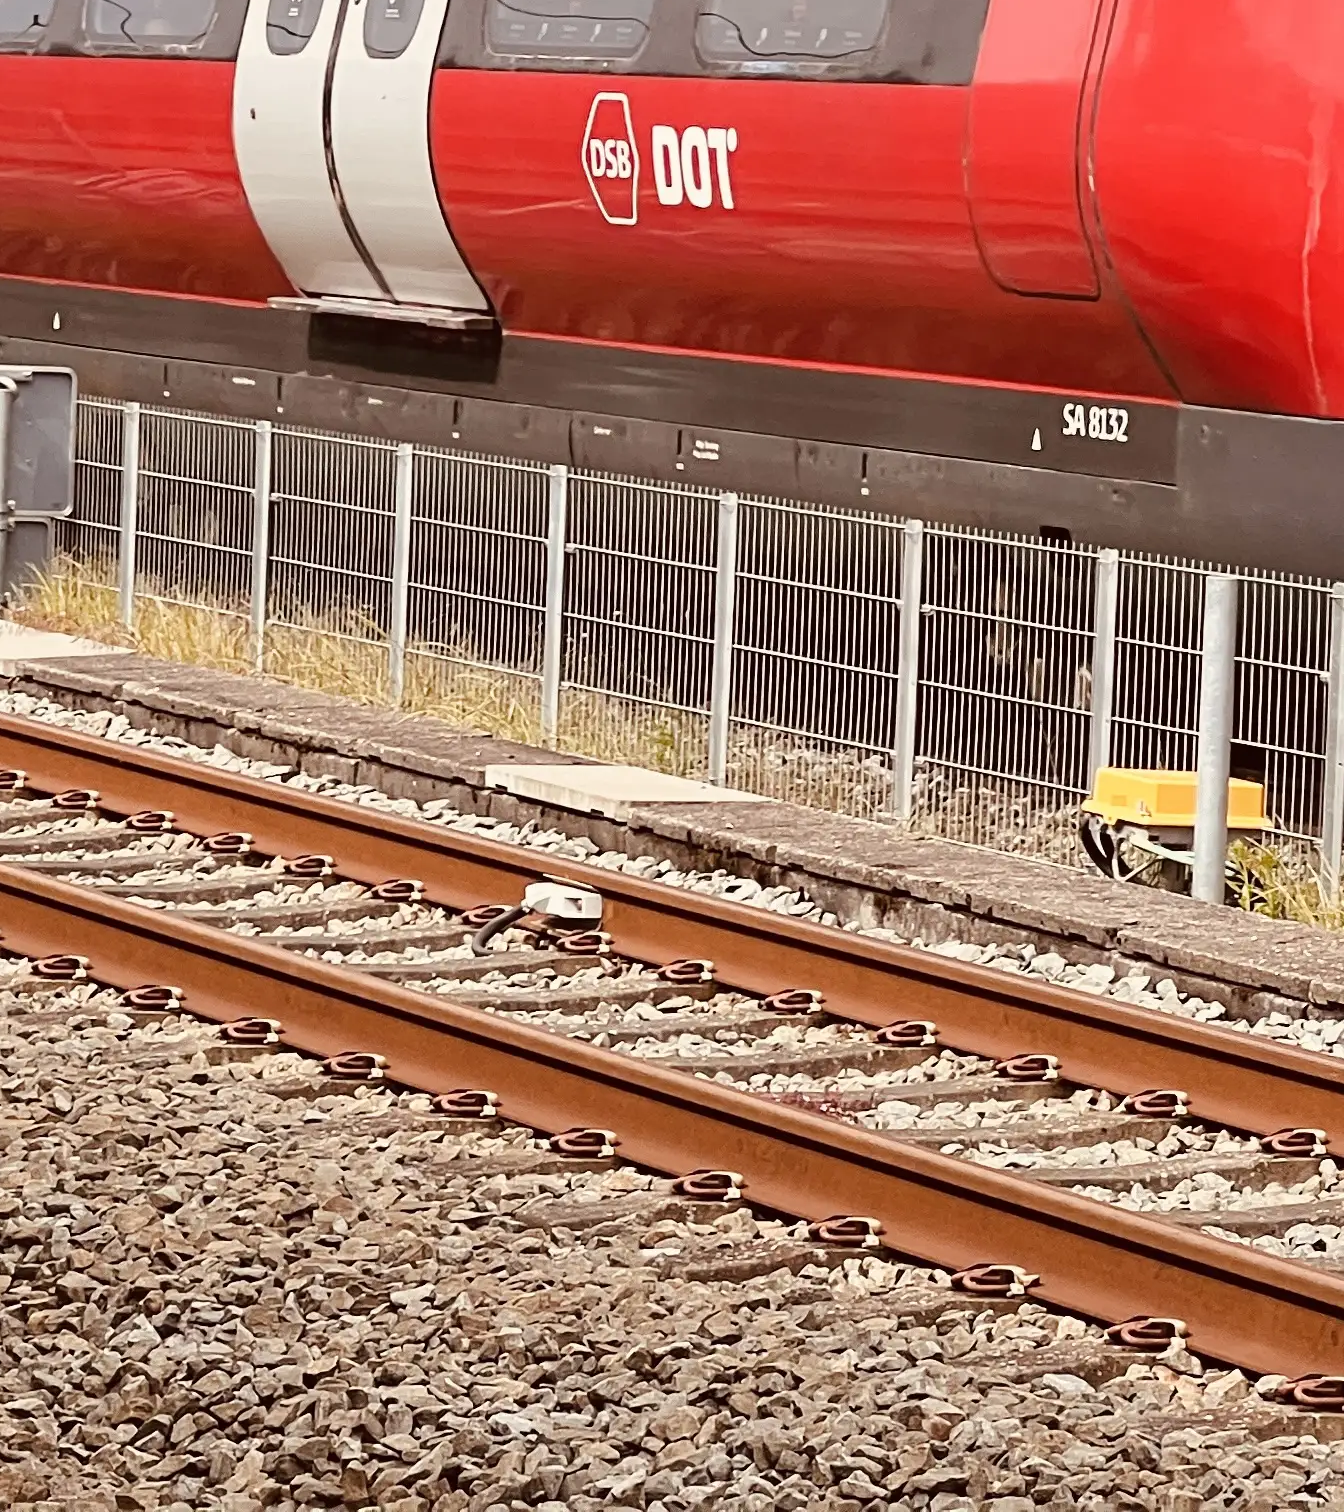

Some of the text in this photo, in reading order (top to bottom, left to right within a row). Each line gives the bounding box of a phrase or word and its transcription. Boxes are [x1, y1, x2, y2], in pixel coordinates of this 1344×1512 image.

[589, 138, 632, 179] DSB
[1062, 402, 1129, 443] SA 8132
